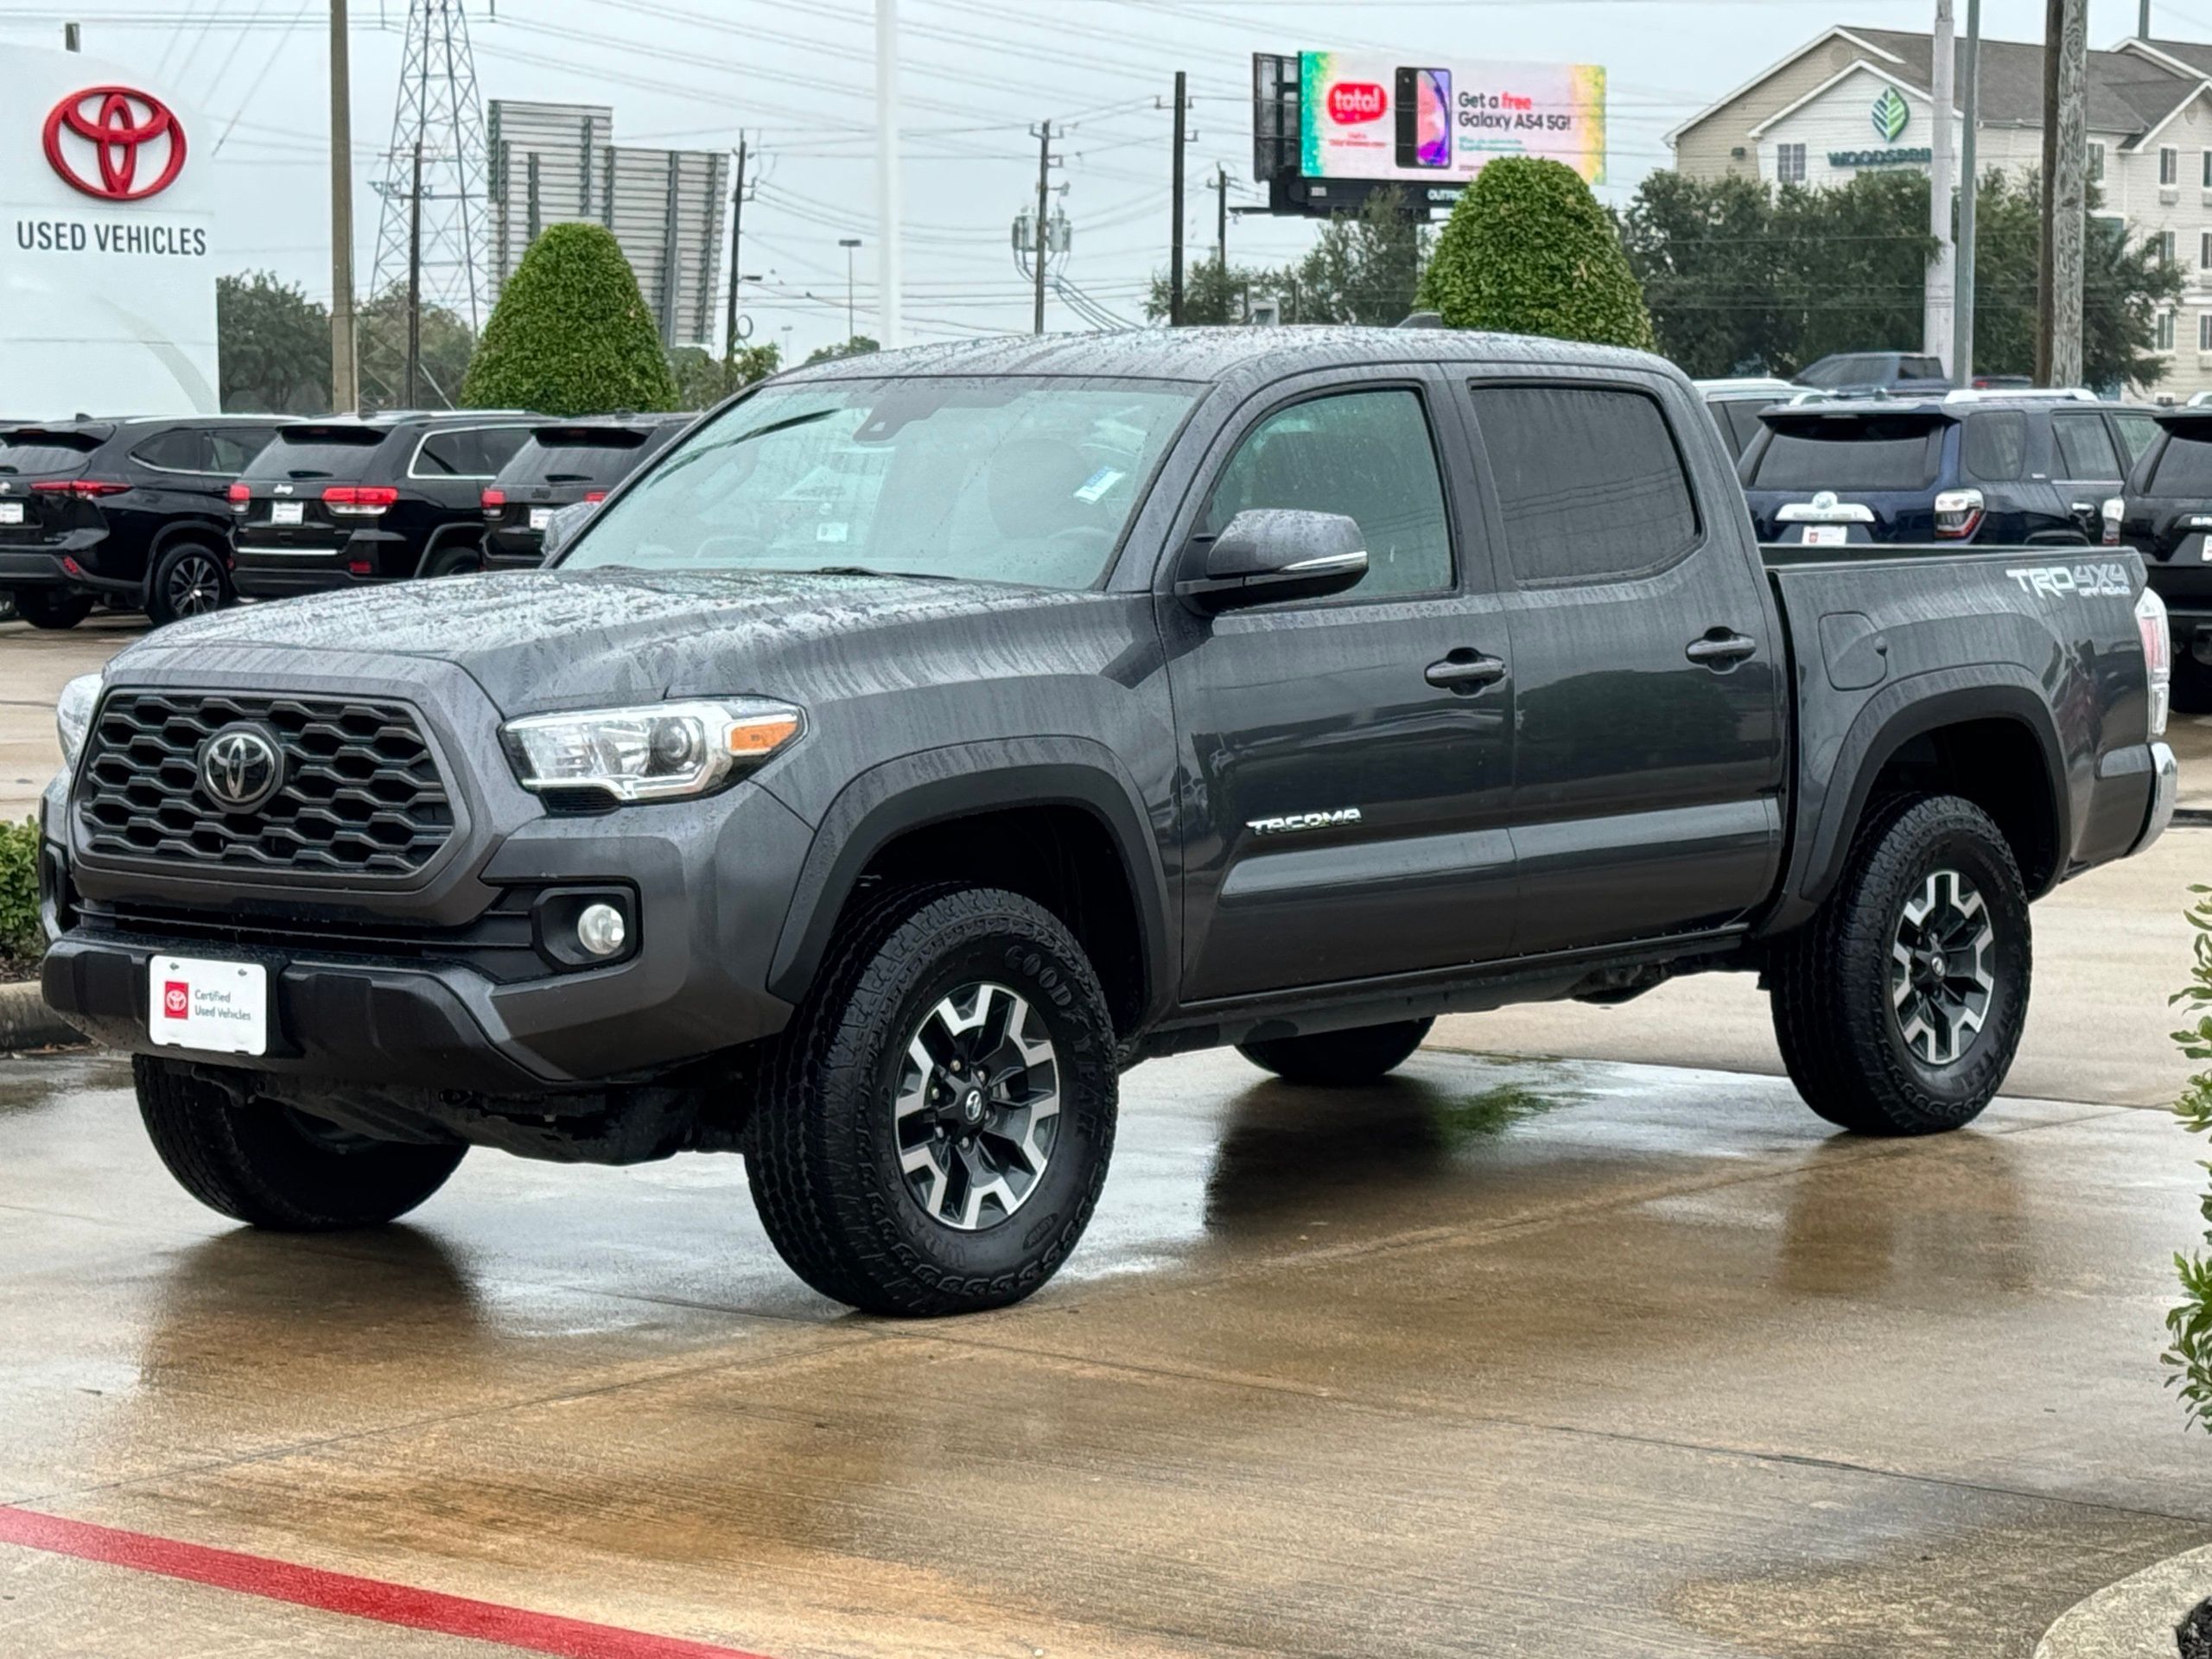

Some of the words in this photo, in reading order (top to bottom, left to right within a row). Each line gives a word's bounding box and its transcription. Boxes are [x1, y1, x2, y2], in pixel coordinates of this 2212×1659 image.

[1334, 86, 1380, 112] total
[1459, 92, 1486, 108] Get
[1489, 95, 1499, 109] a
[1502, 92, 1532, 110] free
[1459, 111, 1512, 131] Galaxy
[1514, 113, 1544, 130] A54
[1547, 114, 1572, 130] 5G!
[16, 220, 86, 251] USED
[93, 223, 207, 257] VEHICLES
[2005, 567, 2077, 599] TRD
[1245, 808, 1363, 833] TACOMA
[194, 988, 232, 1002] Certified
[194, 1004, 216, 1018] Used
[217, 1007, 251, 1020] Vehicles
